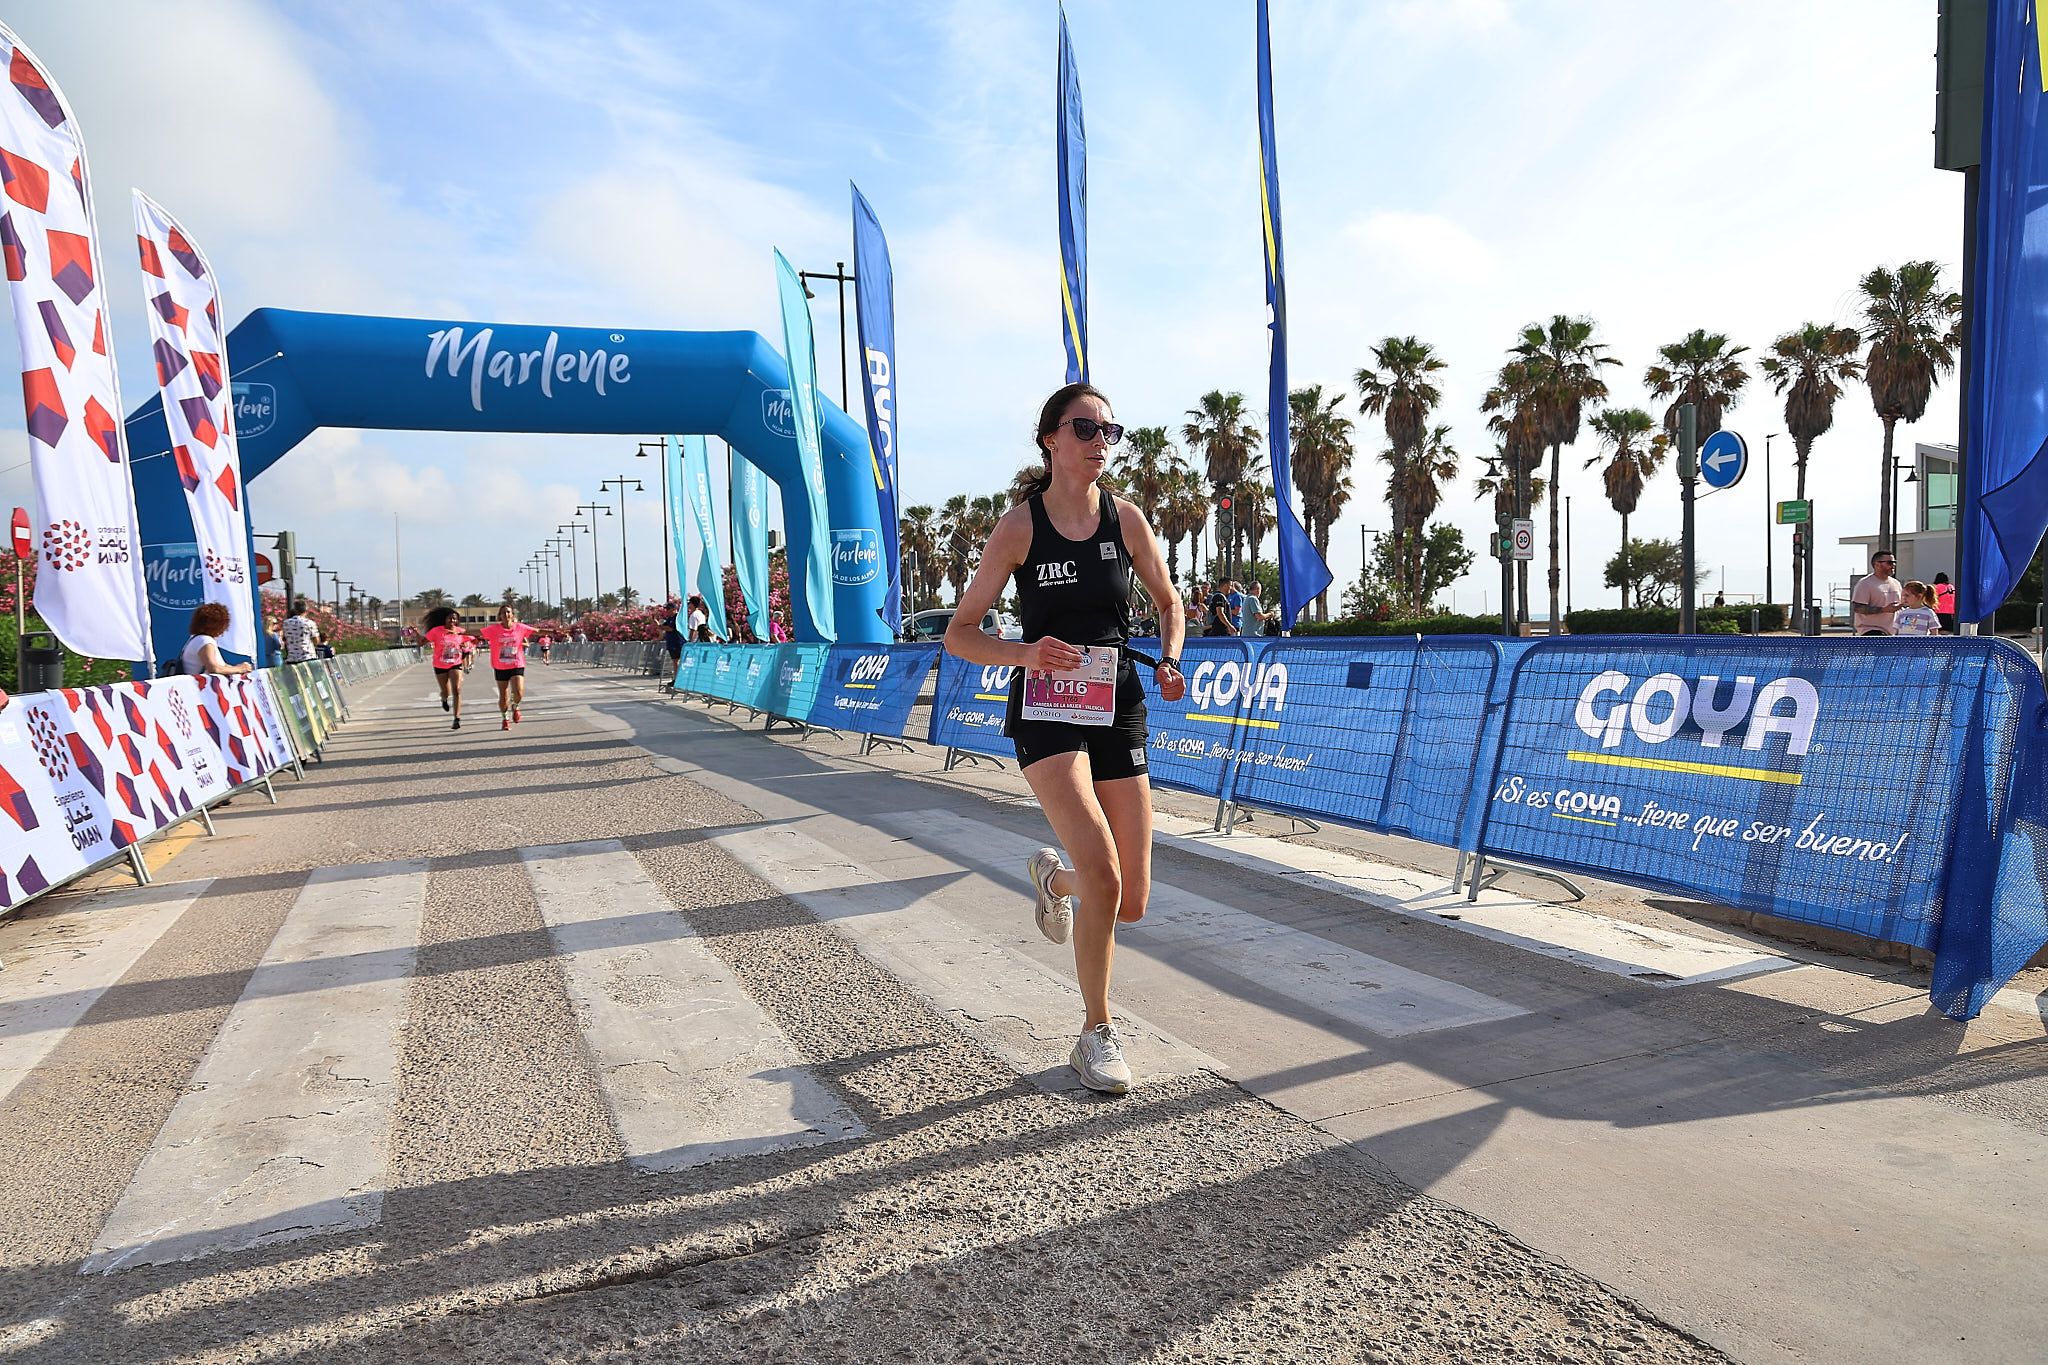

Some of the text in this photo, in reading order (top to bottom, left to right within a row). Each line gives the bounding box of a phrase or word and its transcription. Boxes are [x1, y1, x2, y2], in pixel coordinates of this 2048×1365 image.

[424, 326, 631, 412] Marlene
[1519, 536, 1528, 544] 30
[1036, 560, 1077, 581] ZRC
[851, 654, 890, 682] GOYA
[981, 665, 1013, 693] GO
[1053, 680, 1088, 695] 016
[1190, 660, 1289, 712] GOYA
[965, 712, 985, 724] GOYA
[1575, 669, 1820, 756] GOYA
[1178, 738, 1205, 755] GOYA
[1234, 749, 1254, 773] que
[1255, 751, 1273, 766] ser
[1273, 745, 1314, 772] bueno!
[72, 825, 103, 852] OMAN
[1526, 790, 1551, 808] es
[1554, 789, 1621, 818] GOYA
[1692, 814, 1739, 852] que
[1742, 821, 1792, 845] ser
[1795, 810, 1909, 863] bueno!
